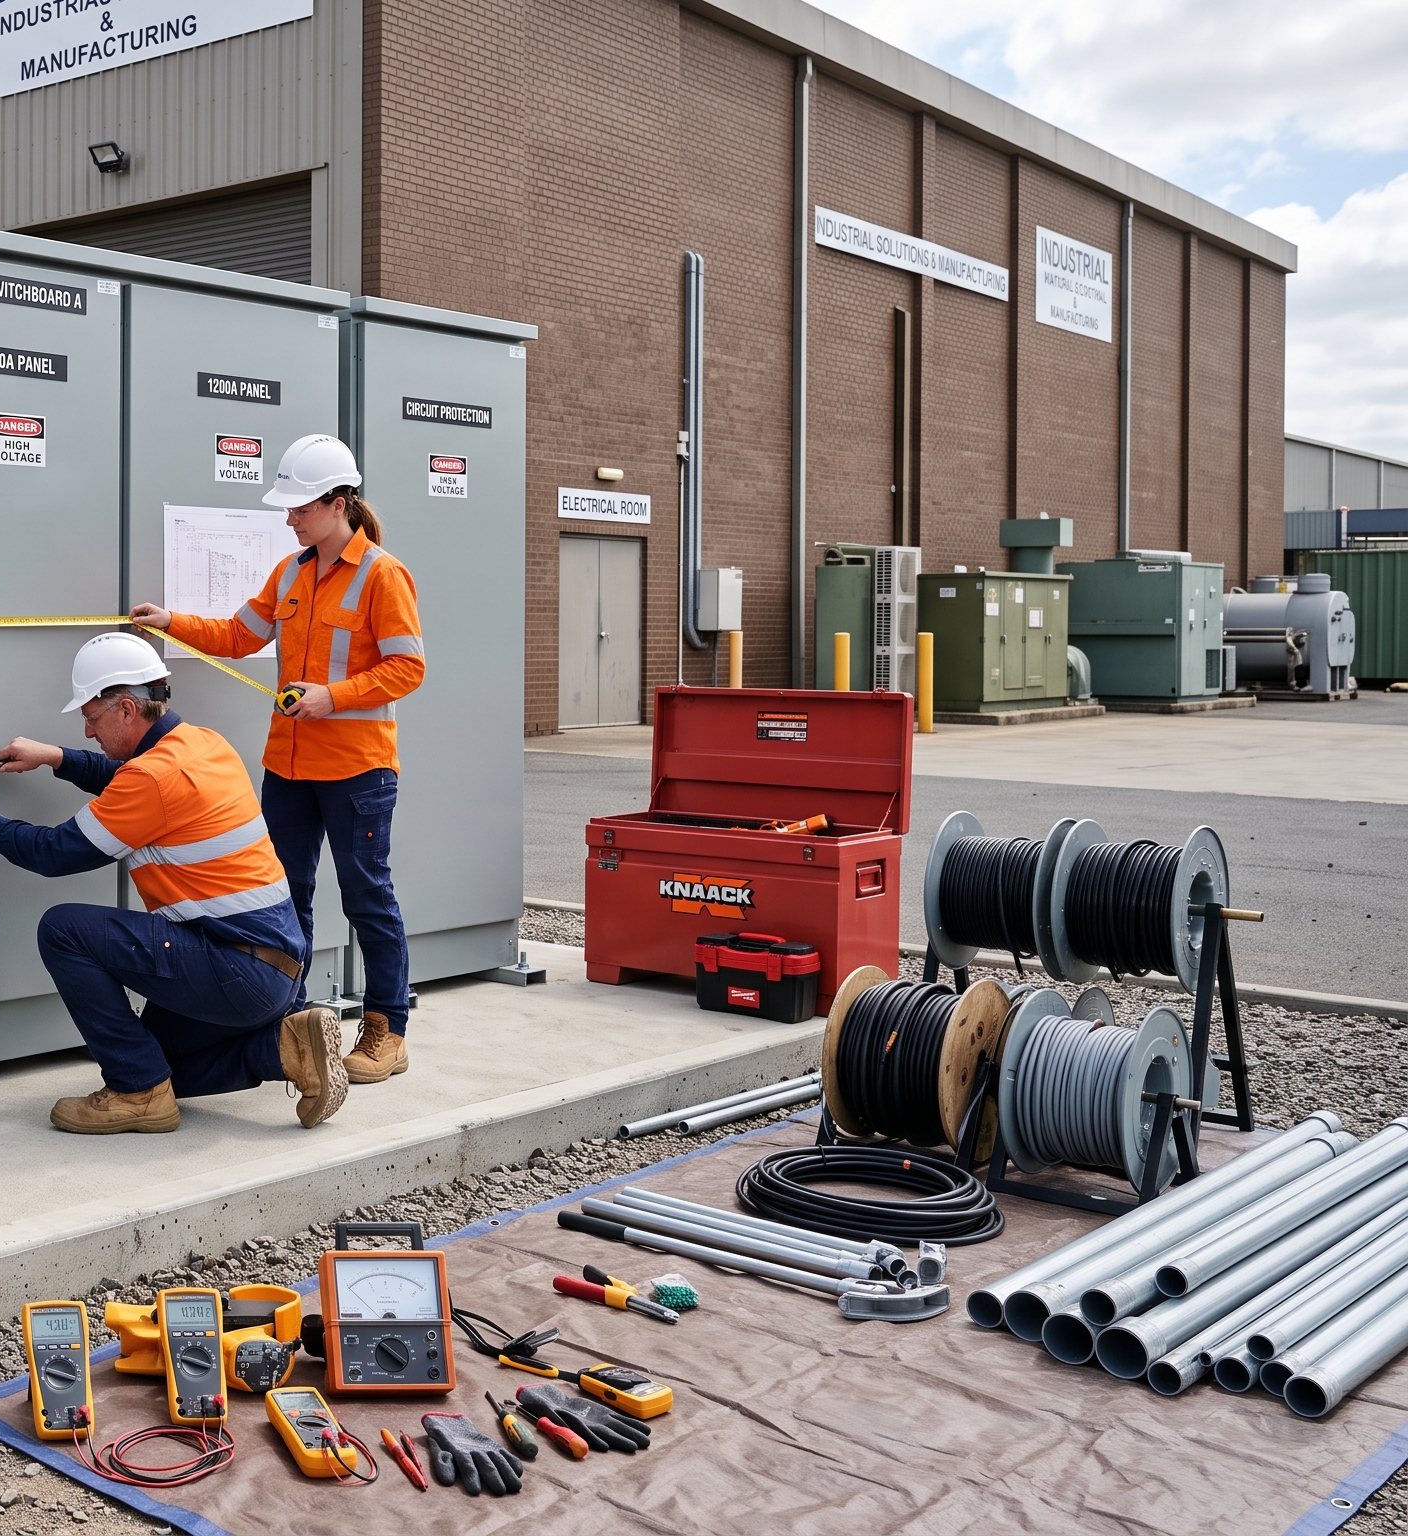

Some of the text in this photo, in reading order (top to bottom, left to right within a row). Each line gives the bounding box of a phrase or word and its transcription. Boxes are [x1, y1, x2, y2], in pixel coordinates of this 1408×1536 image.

[100, 11, 114, 32] &
[20, 14, 197, 81] MANUFACTURING
[816, 215, 874, 251] INDUSTRIAL
[876, 234, 929, 267] SOLUTIONS
[938, 254, 1006, 293] MANUFACTURING
[1040, 236, 1109, 285] INDUSTRIAL
[73, 293, 82, 310] A
[17, 354, 56, 375] PANEL
[207, 377, 272, 400] 1200A PANEL
[406, 401, 490, 425] CIRCUIT PROTECTION
[4, 440, 30, 450] HIGH
[219, 469, 259, 481] VOLTAGE
[431, 485, 465, 496] VOLTAGE
[562, 495, 647, 517] ELECTRICAL ROOM
[659, 879, 752, 906] KNAACK
